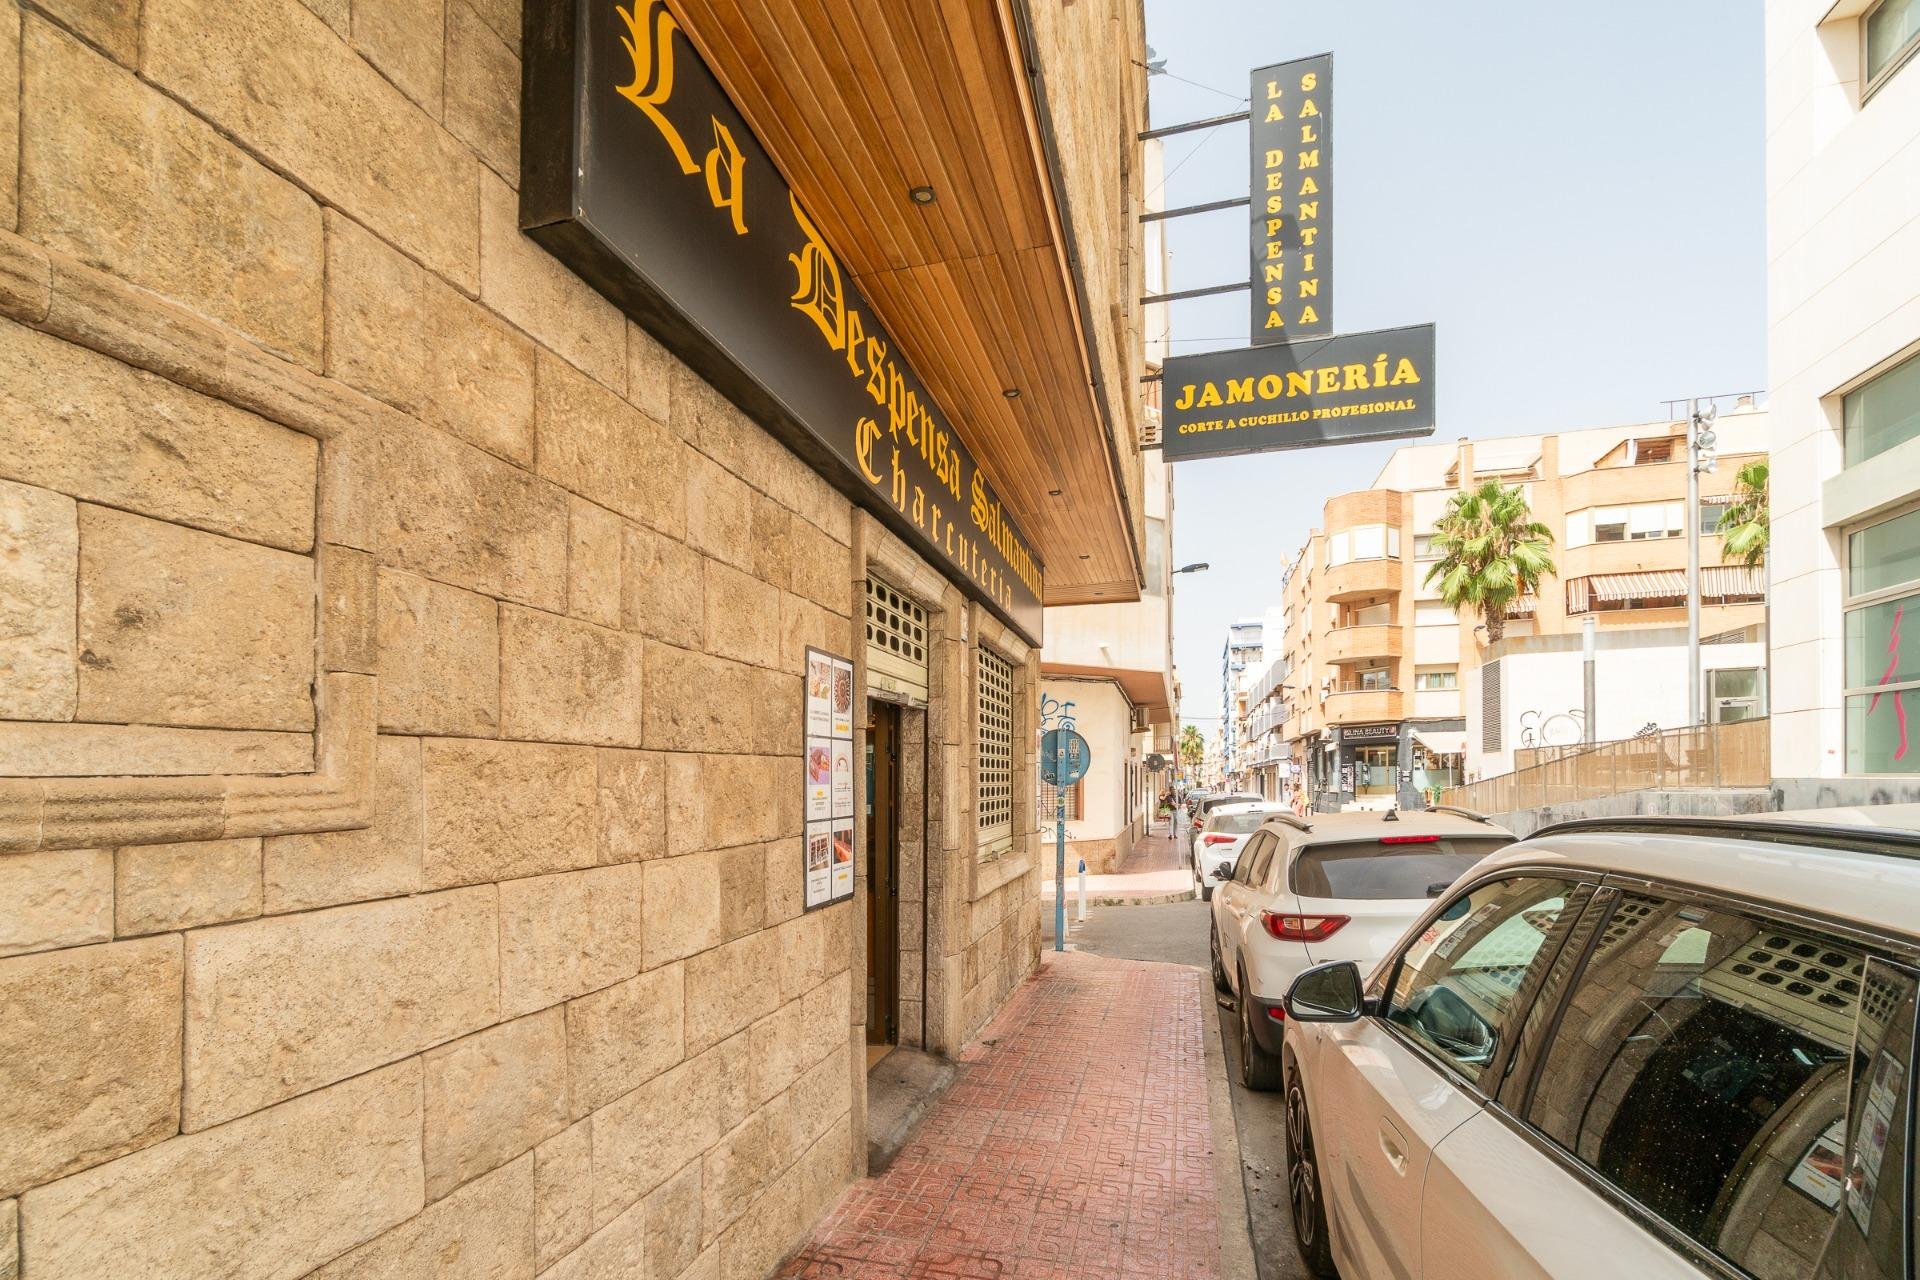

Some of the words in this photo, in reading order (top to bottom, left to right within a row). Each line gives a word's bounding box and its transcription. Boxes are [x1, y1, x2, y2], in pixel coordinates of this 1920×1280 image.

[1265, 81, 1284, 123] LA
[1265, 149, 1284, 329] DESPENSA
[1299, 73, 1319, 324] SALMANTINA
[615, 0, 749, 235] La
[788, 189, 962, 502] Despensa
[970, 468, 1043, 604] Salmantina
[1175, 353, 1420, 410] JAMONERÍA
[1178, 419, 1224, 434] CORTE
[1225, 418, 1236, 429] A
[1238, 410, 1310, 428] CUCHILLO
[1312, 399, 1417, 419] PROFESIONAL
